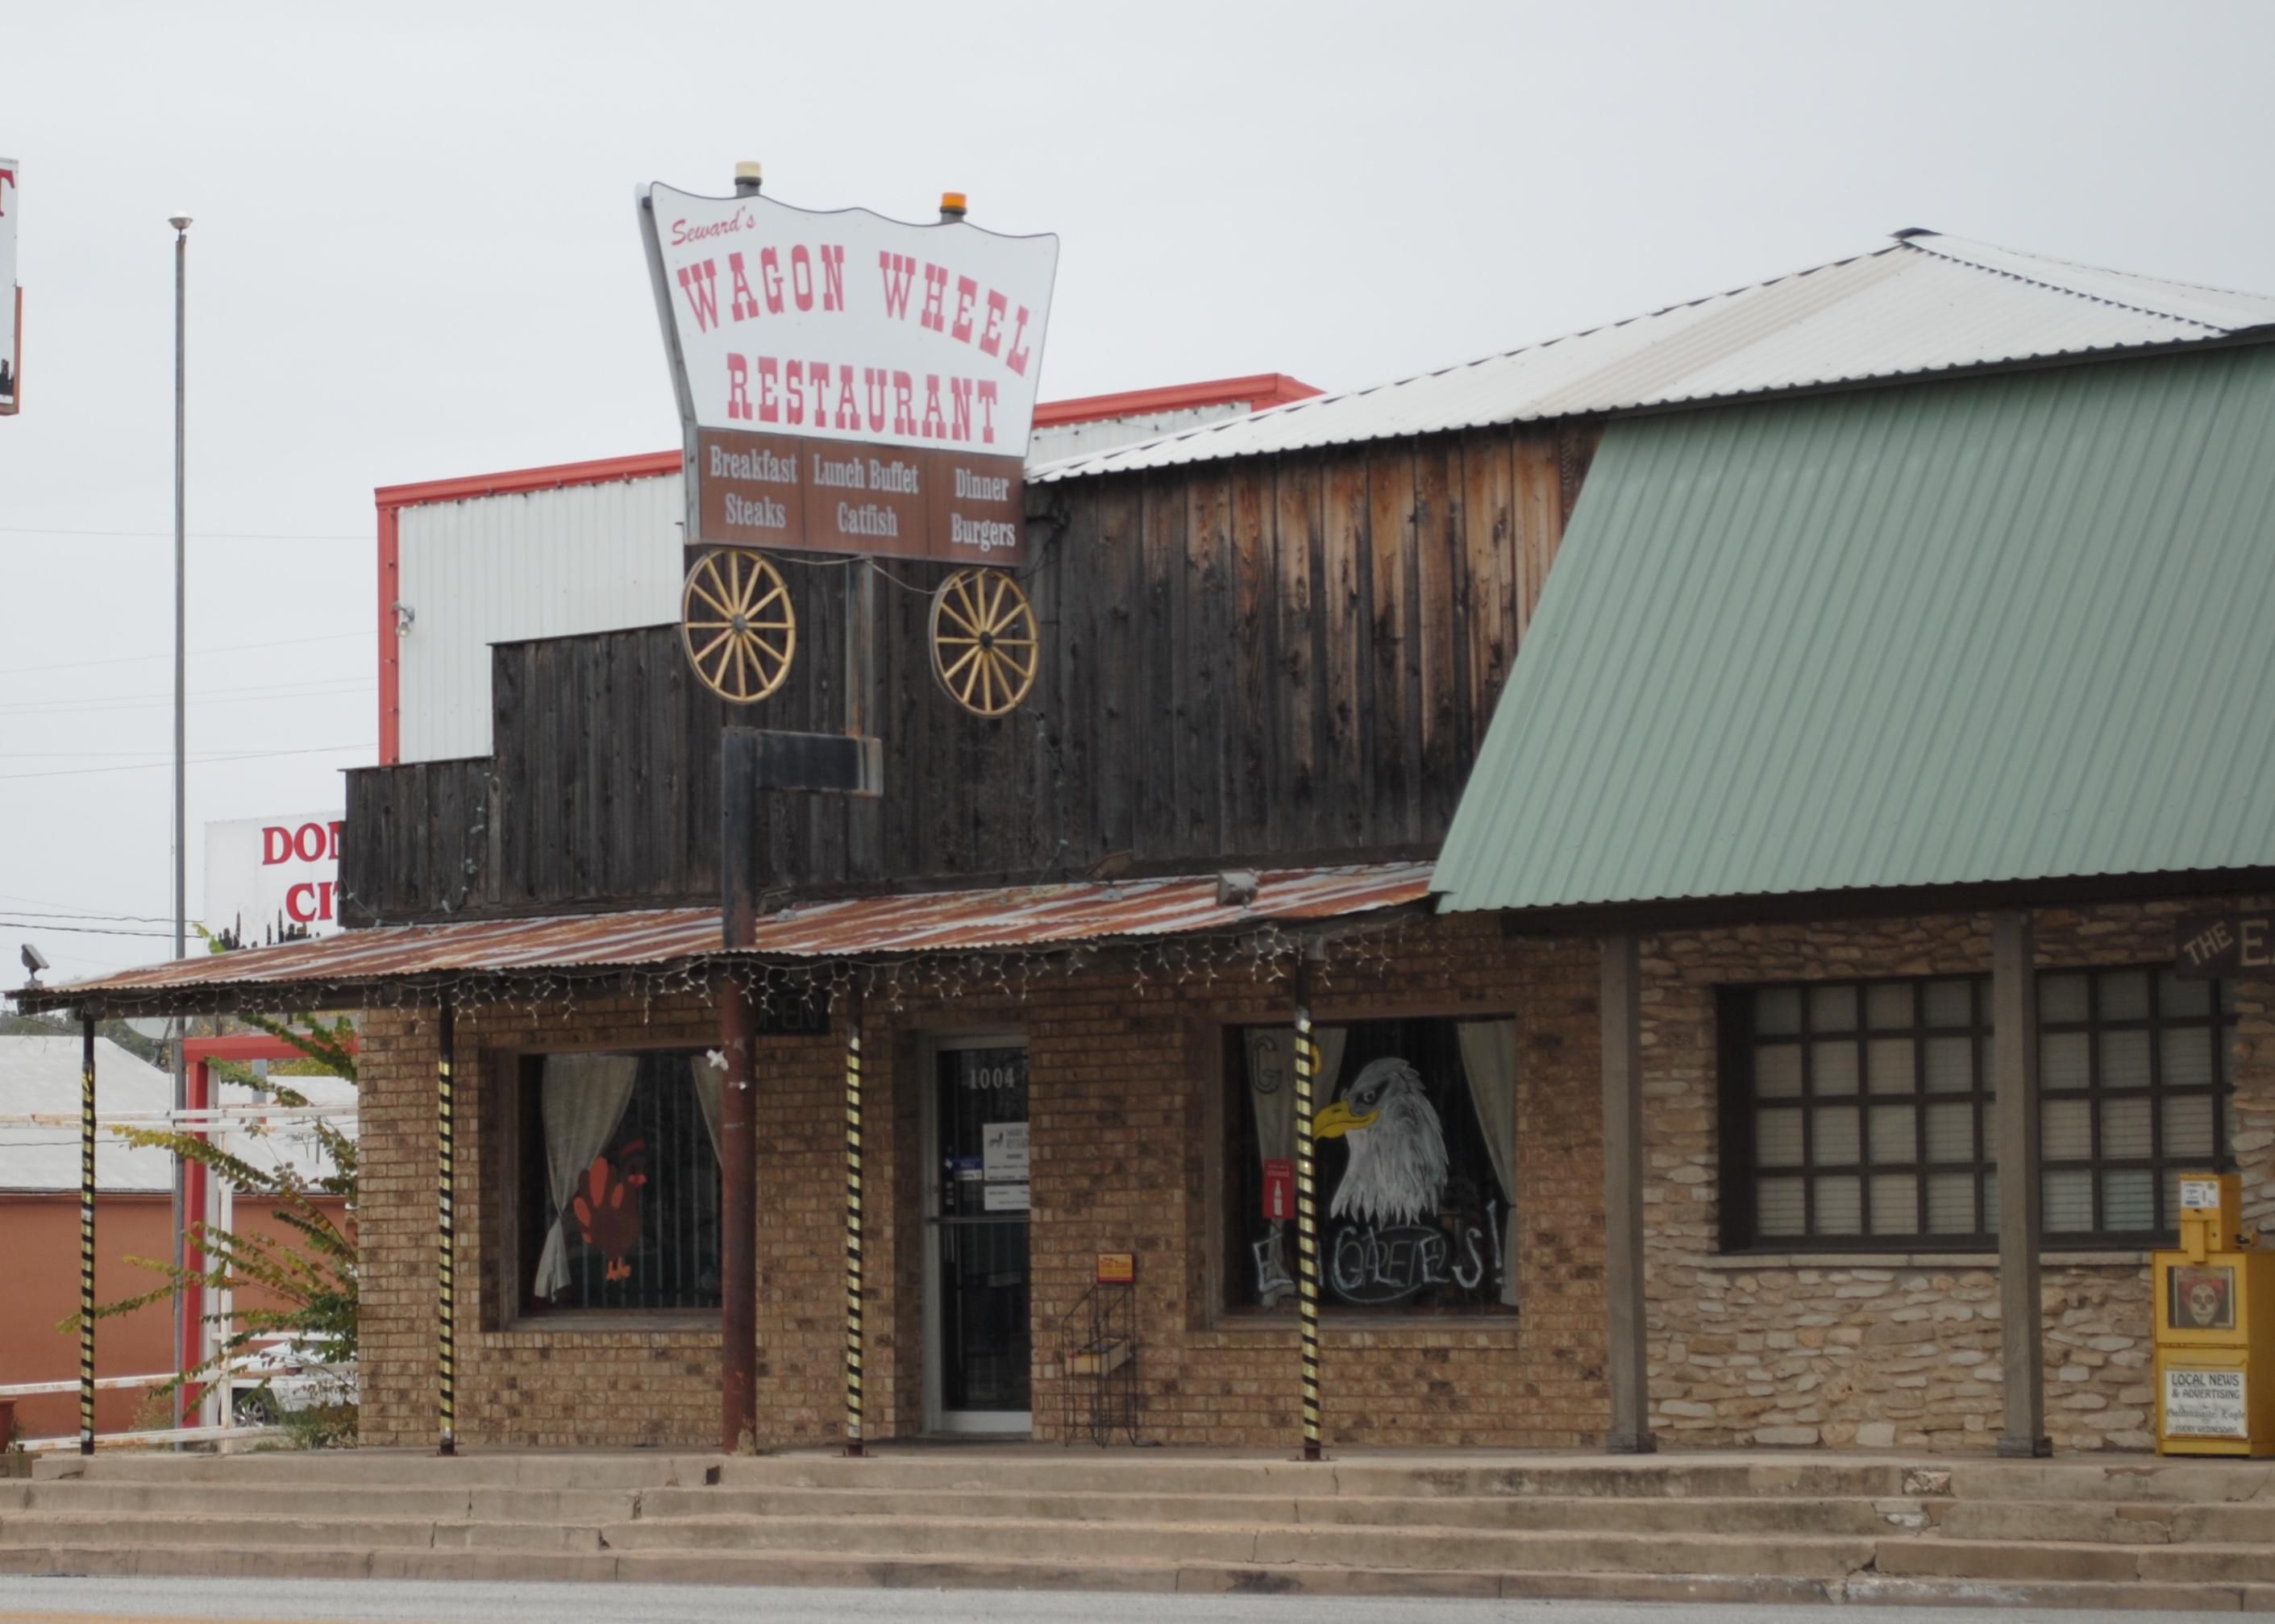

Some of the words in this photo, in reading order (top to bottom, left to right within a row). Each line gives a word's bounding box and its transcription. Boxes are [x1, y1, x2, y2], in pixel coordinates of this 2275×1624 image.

[671, 206, 756, 247] Seward's
[676, 244, 845, 334] WAGON
[879, 250, 1031, 377] WHEEL
[726, 352, 998, 444] RESTAURANT
[709, 445, 798, 484] Breakfast
[813, 454, 865, 490] Lunch
[869, 459, 920, 495] Buffet
[955, 467, 1009, 502] Dinner
[725, 492, 787, 530] Steaks
[837, 501, 899, 538] Catfish
[950, 513, 1017, 553] Burgers
[2182, 920, 2234, 966] THE
[2239, 919, 2275, 966] E
[969, 1067, 1016, 1090] 1004
[2171, 1373, 2206, 1386] LOCAL
[2209, 1374, 2240, 1386] NEWS
[2172, 1389, 2179, 1398] &
[2182, 1389, 2240, 1399] ADVERTISING
